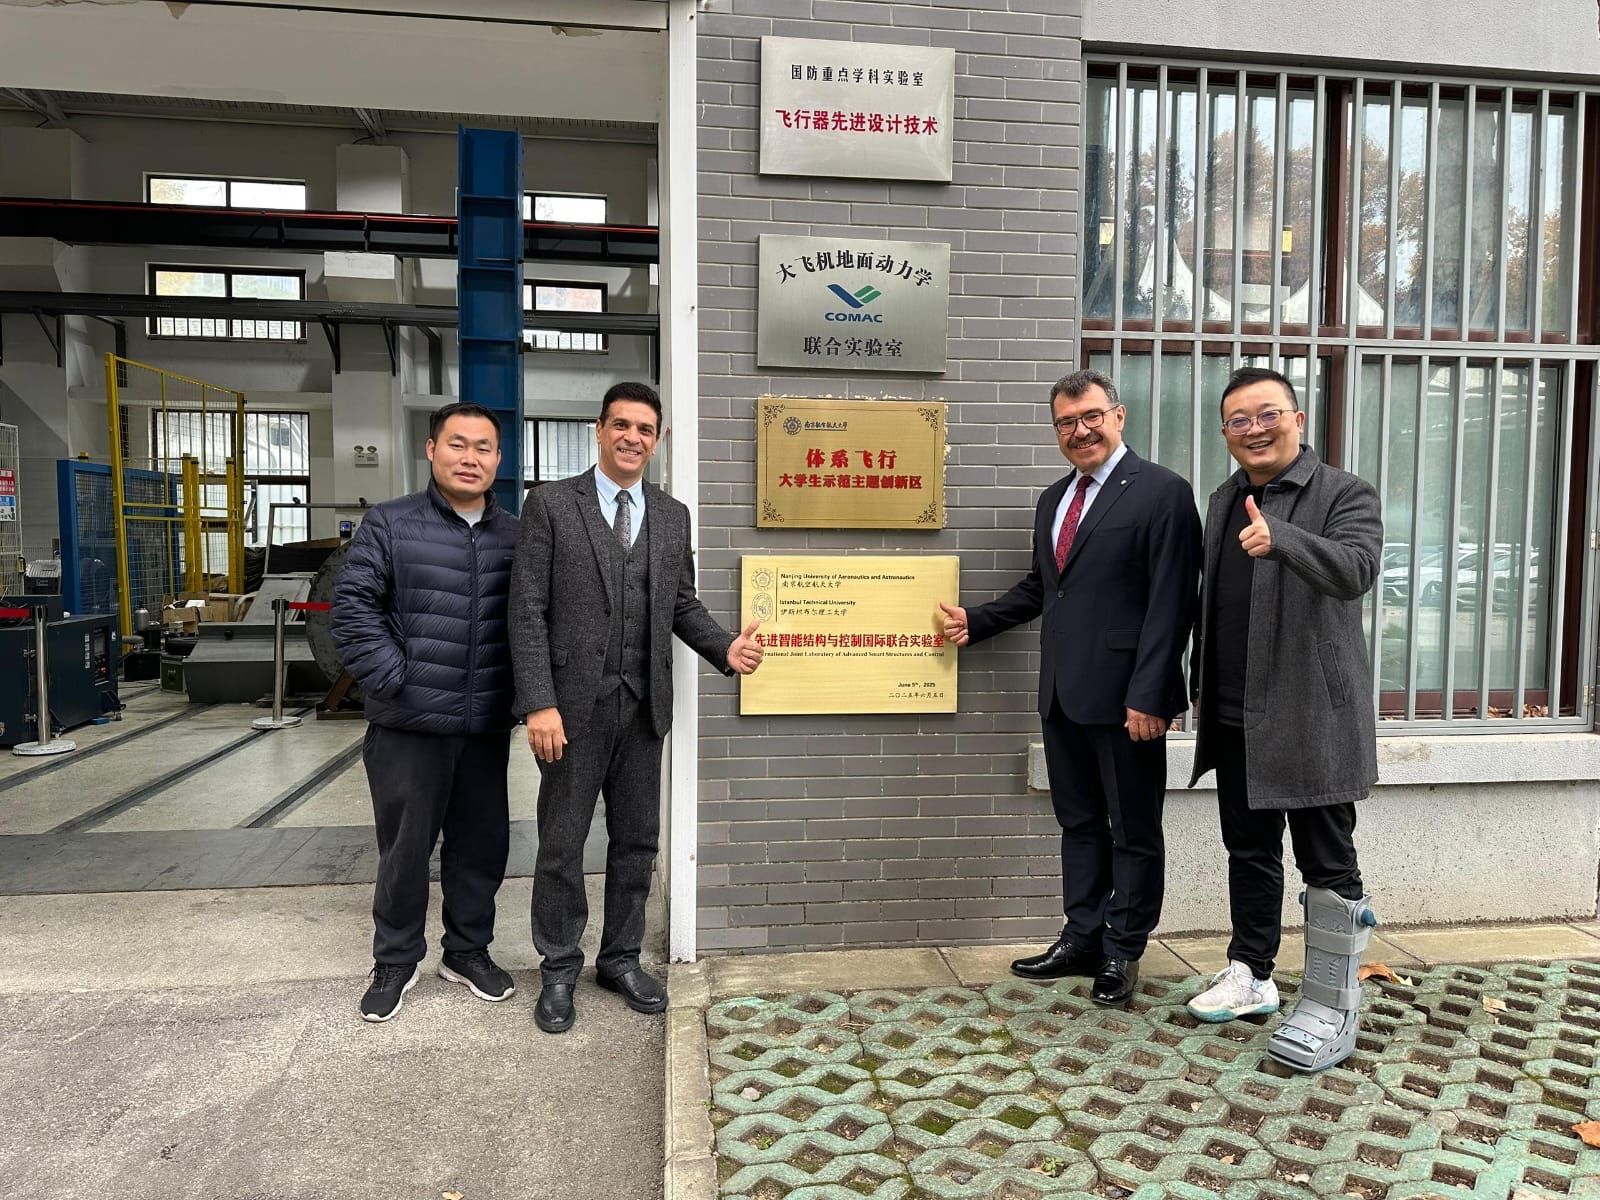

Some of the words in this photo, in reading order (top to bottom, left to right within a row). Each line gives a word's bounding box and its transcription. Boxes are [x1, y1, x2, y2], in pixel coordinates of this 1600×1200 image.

[791, 64, 924, 87] 国防重点学科实验室
[775, 109, 939, 136] 飞行器先进设计技术
[776, 249, 933, 287] 大飞机地面动力学
[824, 312, 883, 323] COMAC
[803, 336, 903, 357] 联合实验室
[806, 448, 898, 470] 体系飞行
[778, 473, 923, 490] 大学生示范主题创新区
[782, 580, 842, 588] 南京航空航天大学
[780, 608, 848, 616] 伊斯坦布尔理工大学
[755, 633, 944, 648] 先进智能结构与控制国际联合实验室
